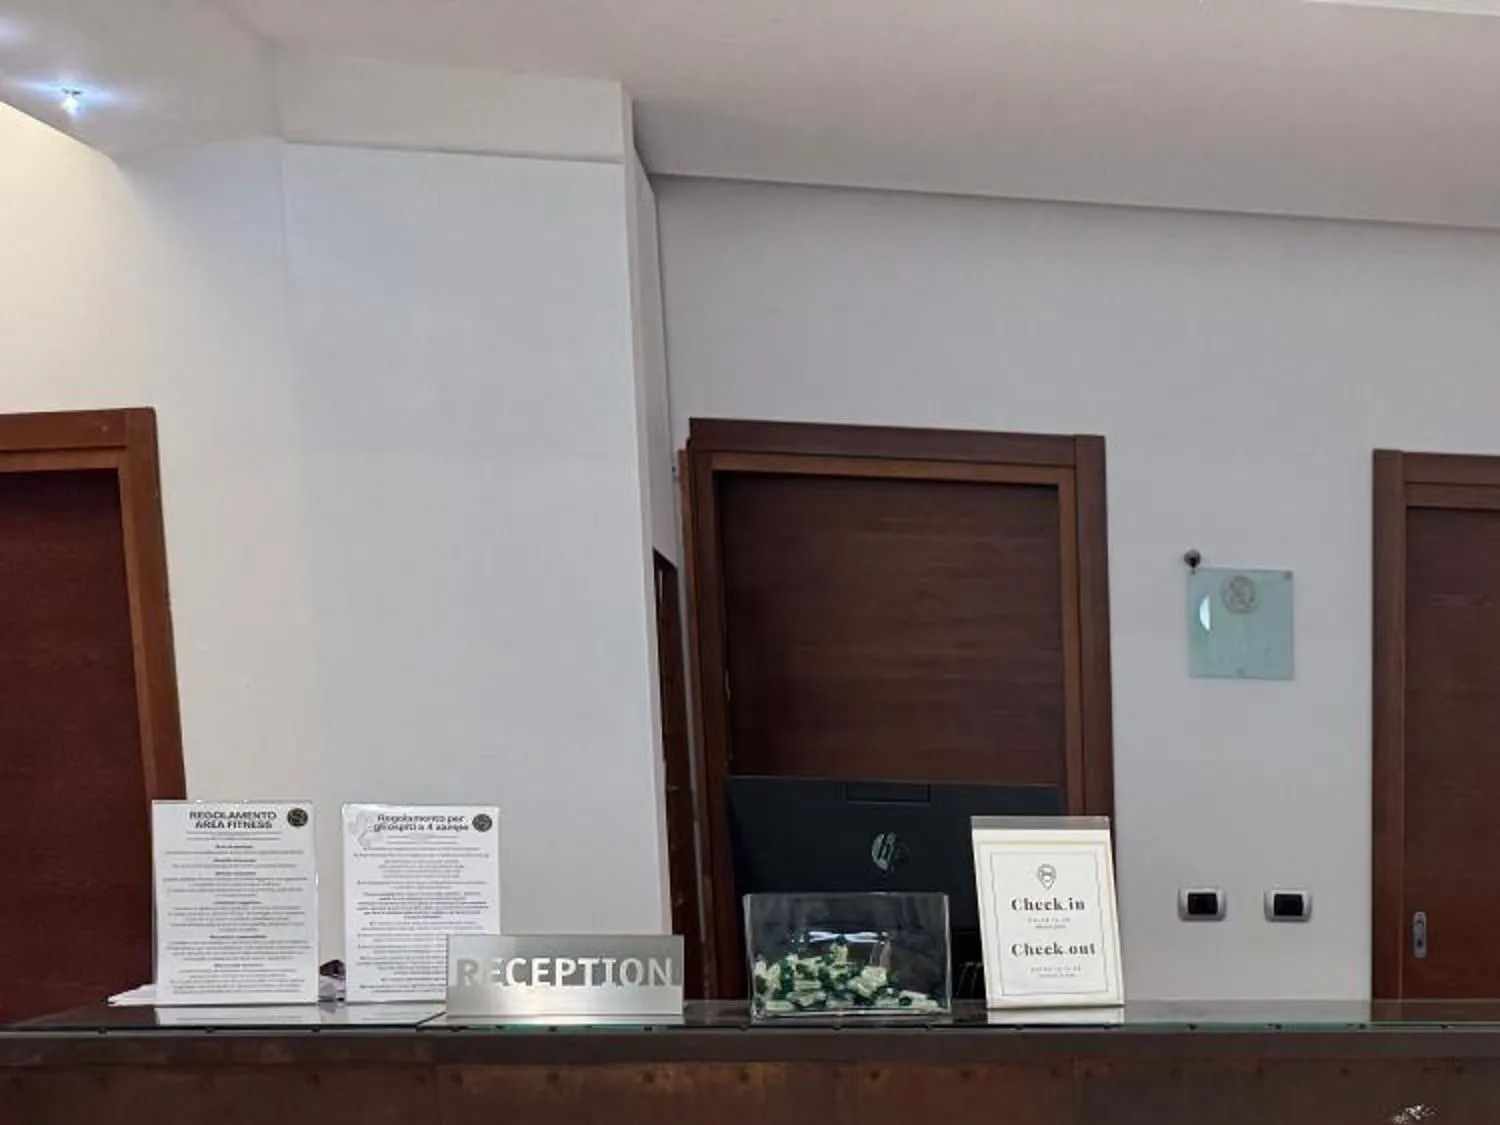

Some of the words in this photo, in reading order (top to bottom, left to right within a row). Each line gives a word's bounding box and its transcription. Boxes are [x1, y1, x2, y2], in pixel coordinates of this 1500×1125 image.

[189, 811, 277, 820] REGOLAMENTO
[377, 813, 445, 823] Regolamento
[195, 820, 225, 829] AREA
[227, 820, 273, 829] FITNESS
[1011, 897, 1063, 911] Check
[1068, 897, 1085, 911] in
[1011, 941, 1063, 957] Check
[1069, 943, 1095, 956] out
[456, 957, 674, 987] RECEPTION
